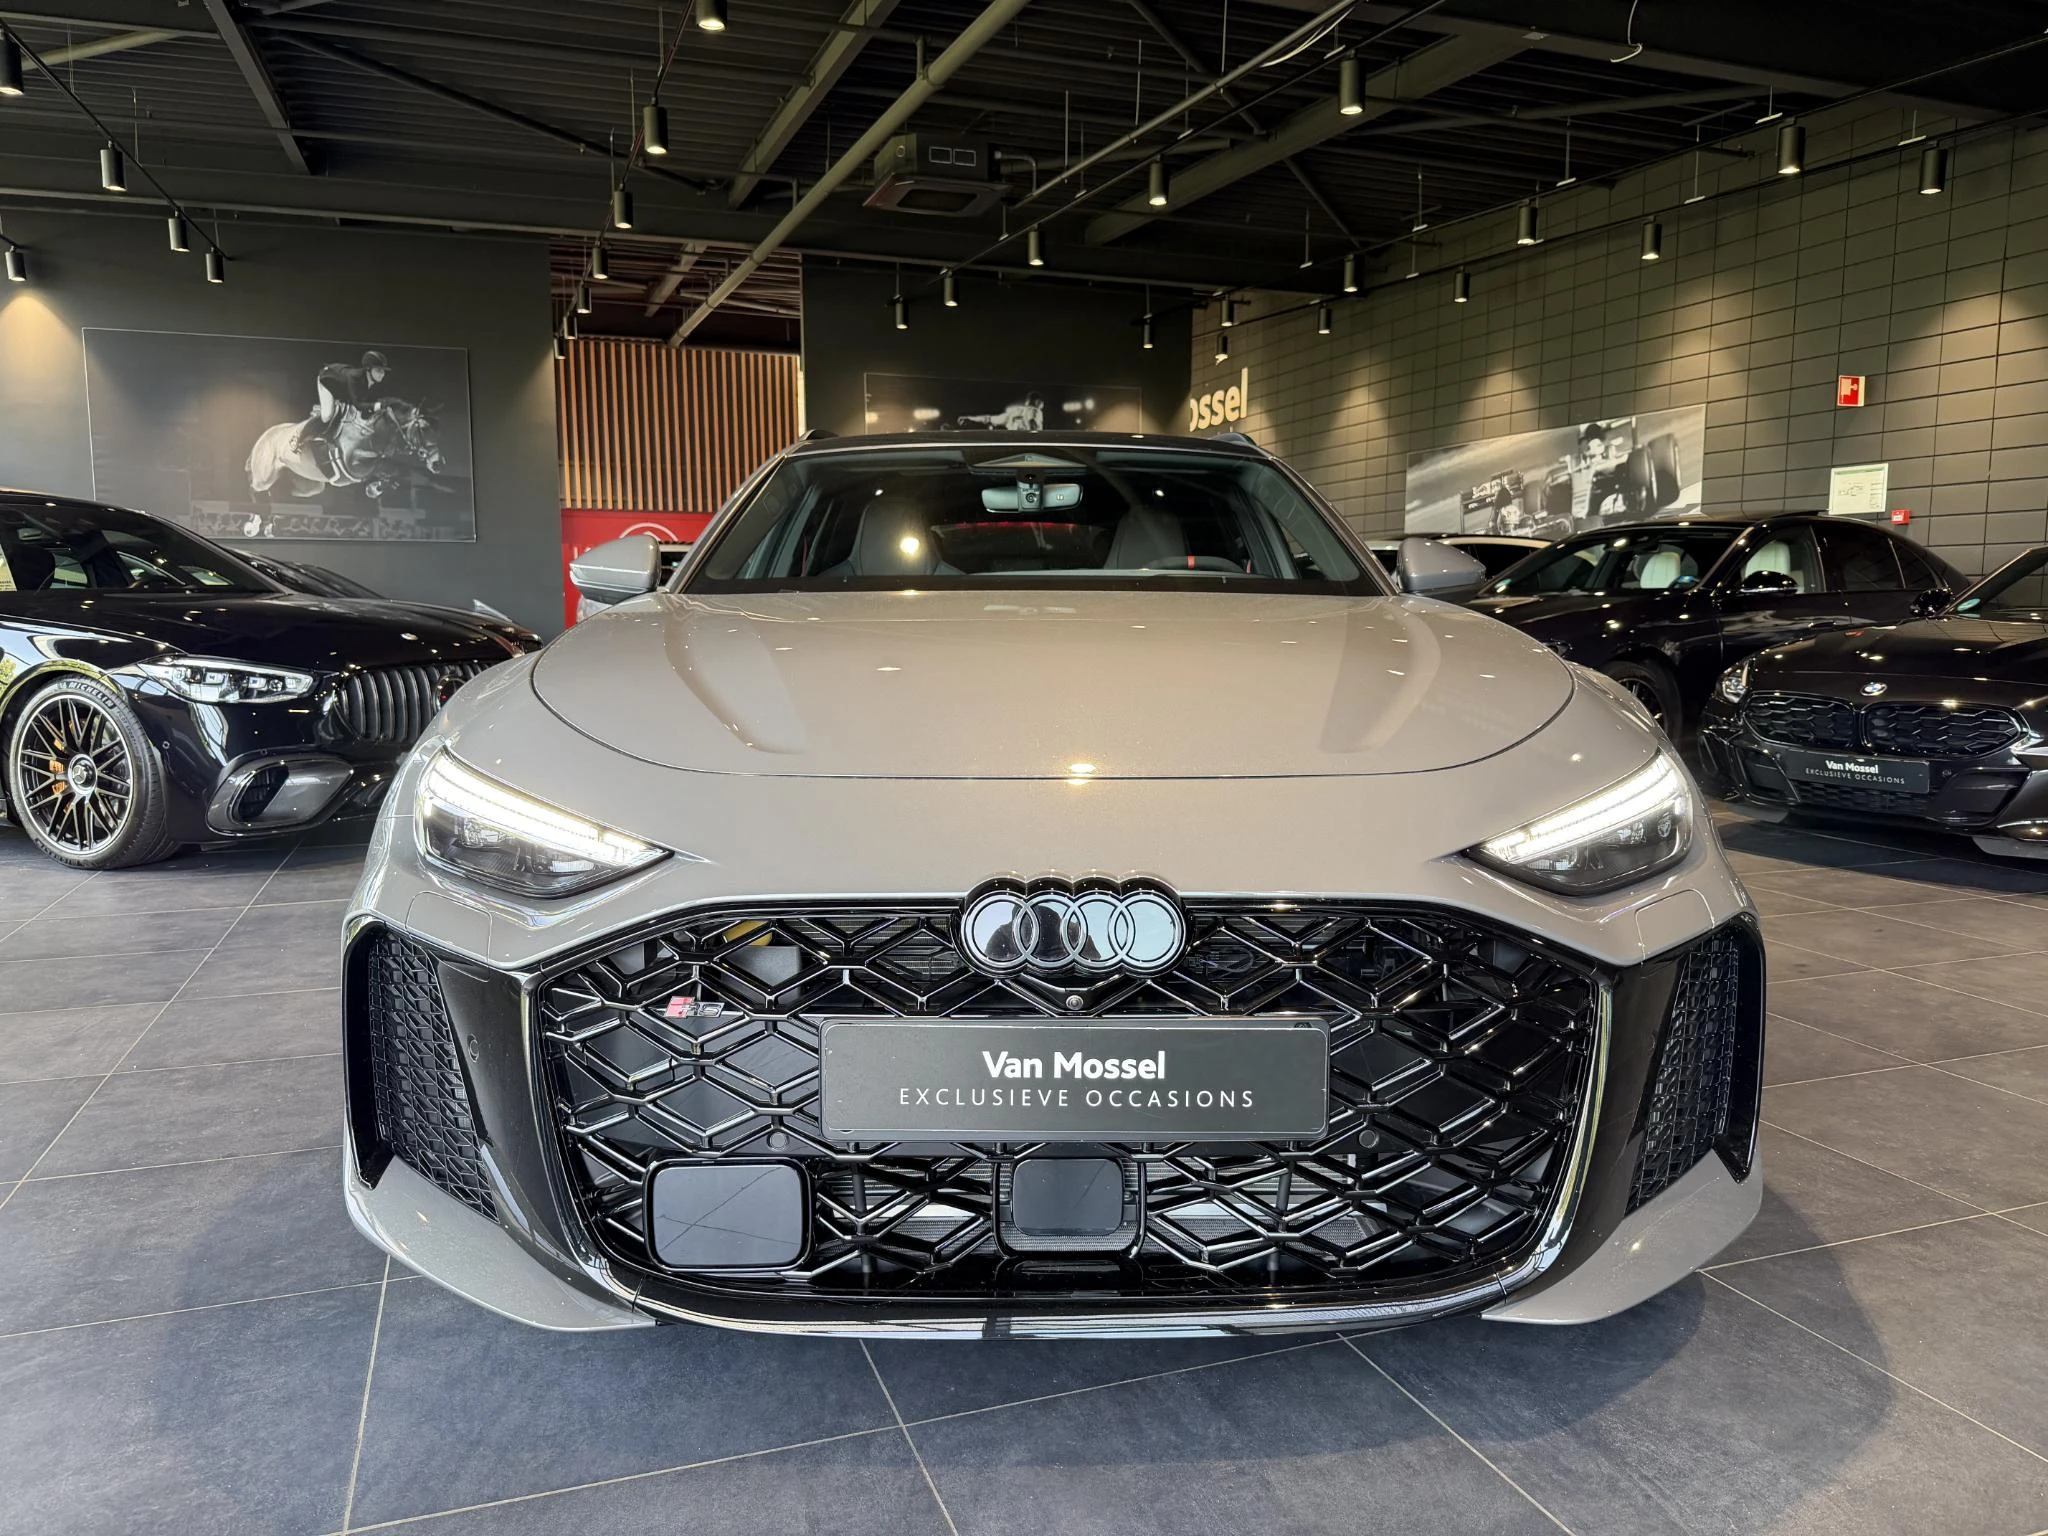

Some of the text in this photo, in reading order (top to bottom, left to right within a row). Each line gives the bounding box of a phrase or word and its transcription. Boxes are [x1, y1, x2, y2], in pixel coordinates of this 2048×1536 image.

[68, 681, 115, 708] MICHELIN
[1805, 768, 1905, 784] EXCLUSIEVE OCCASIONS
[1825, 760, 1879, 774] Van Mossel
[981, 1051, 1166, 1080] Van Mossel
[899, 1087, 1254, 1108] EXCLUSIEVE OCCASIONS
